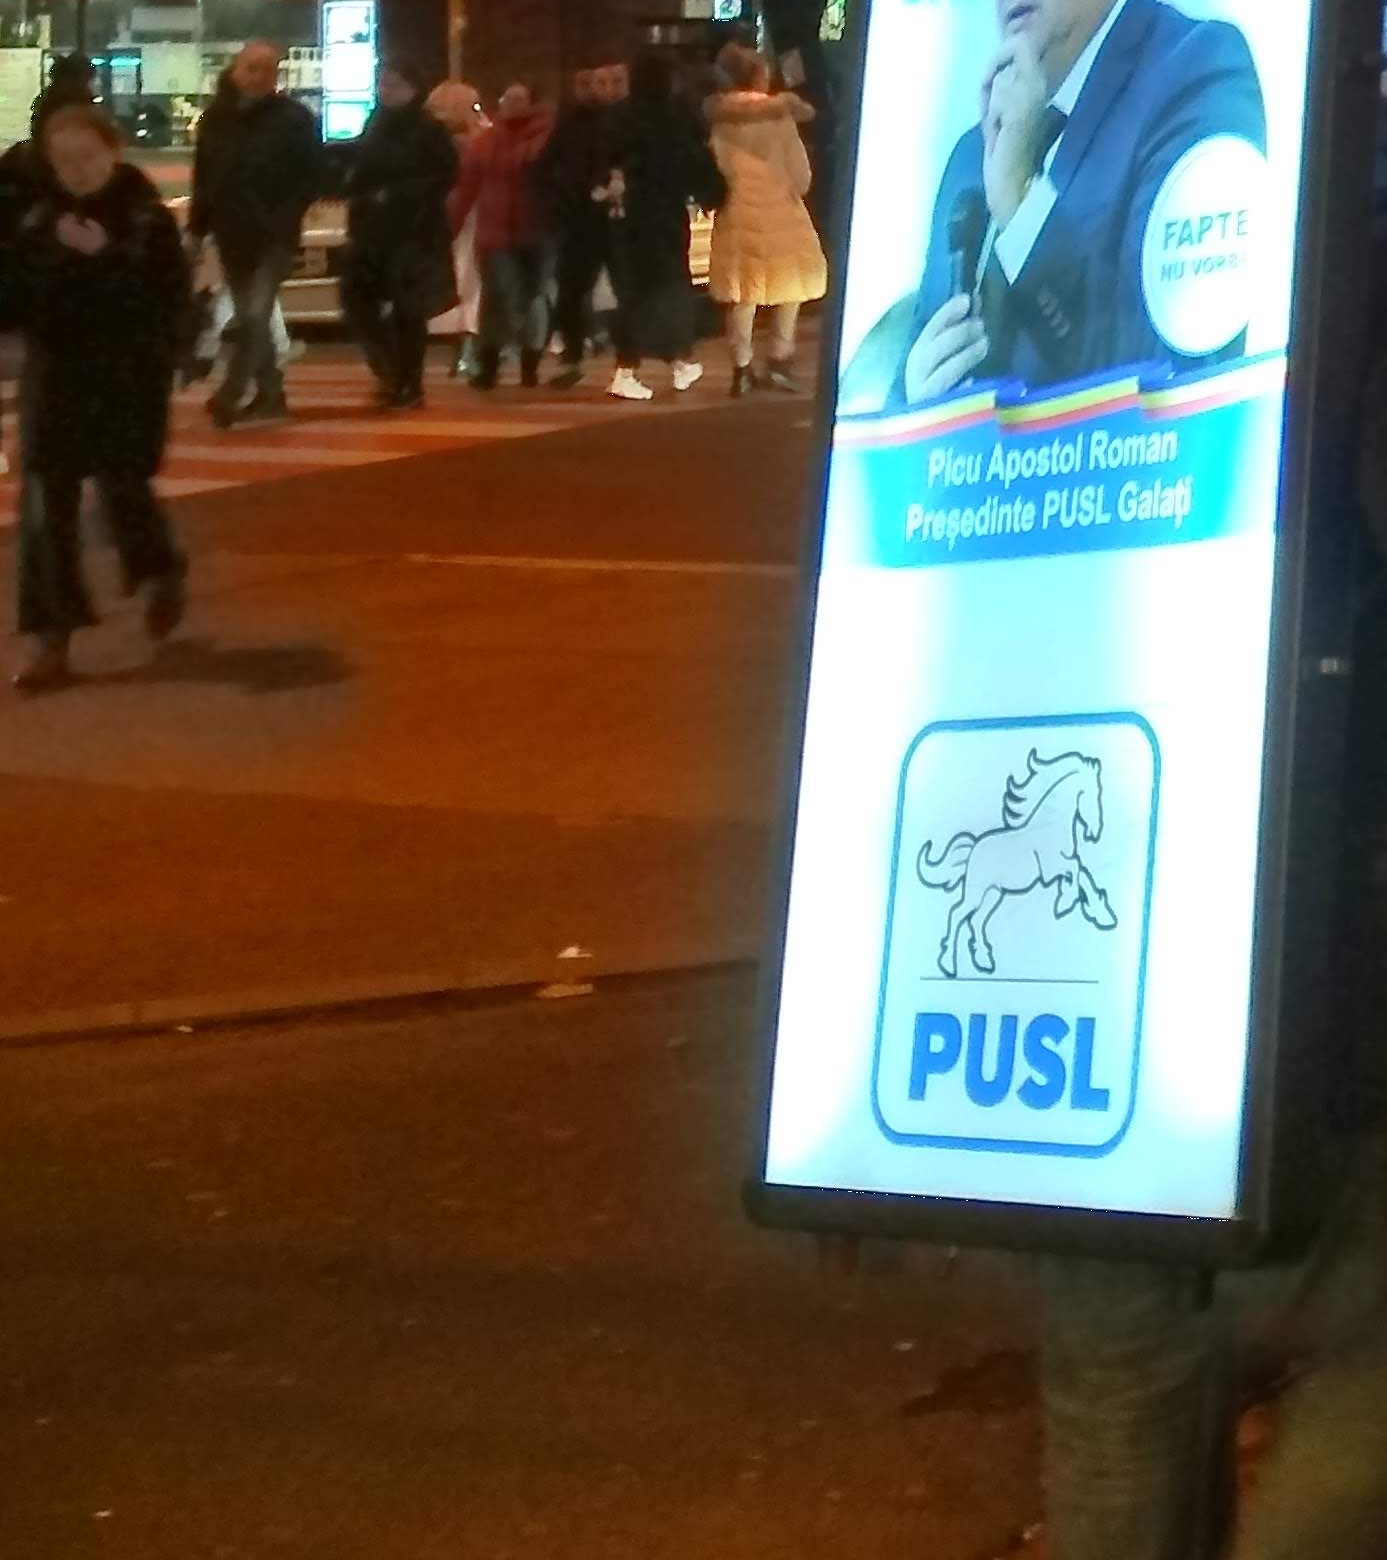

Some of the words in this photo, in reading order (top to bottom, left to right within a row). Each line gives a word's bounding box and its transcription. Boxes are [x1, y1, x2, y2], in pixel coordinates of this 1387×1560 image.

[1162, 209, 1249, 251] FAPTE
[928, 446, 982, 489] Picu
[985, 432, 1085, 490] Apostol
[1089, 428, 1179, 470] Roman
[1041, 484, 1112, 530] PUSL
[908, 1011, 1111, 1112] PUSL
